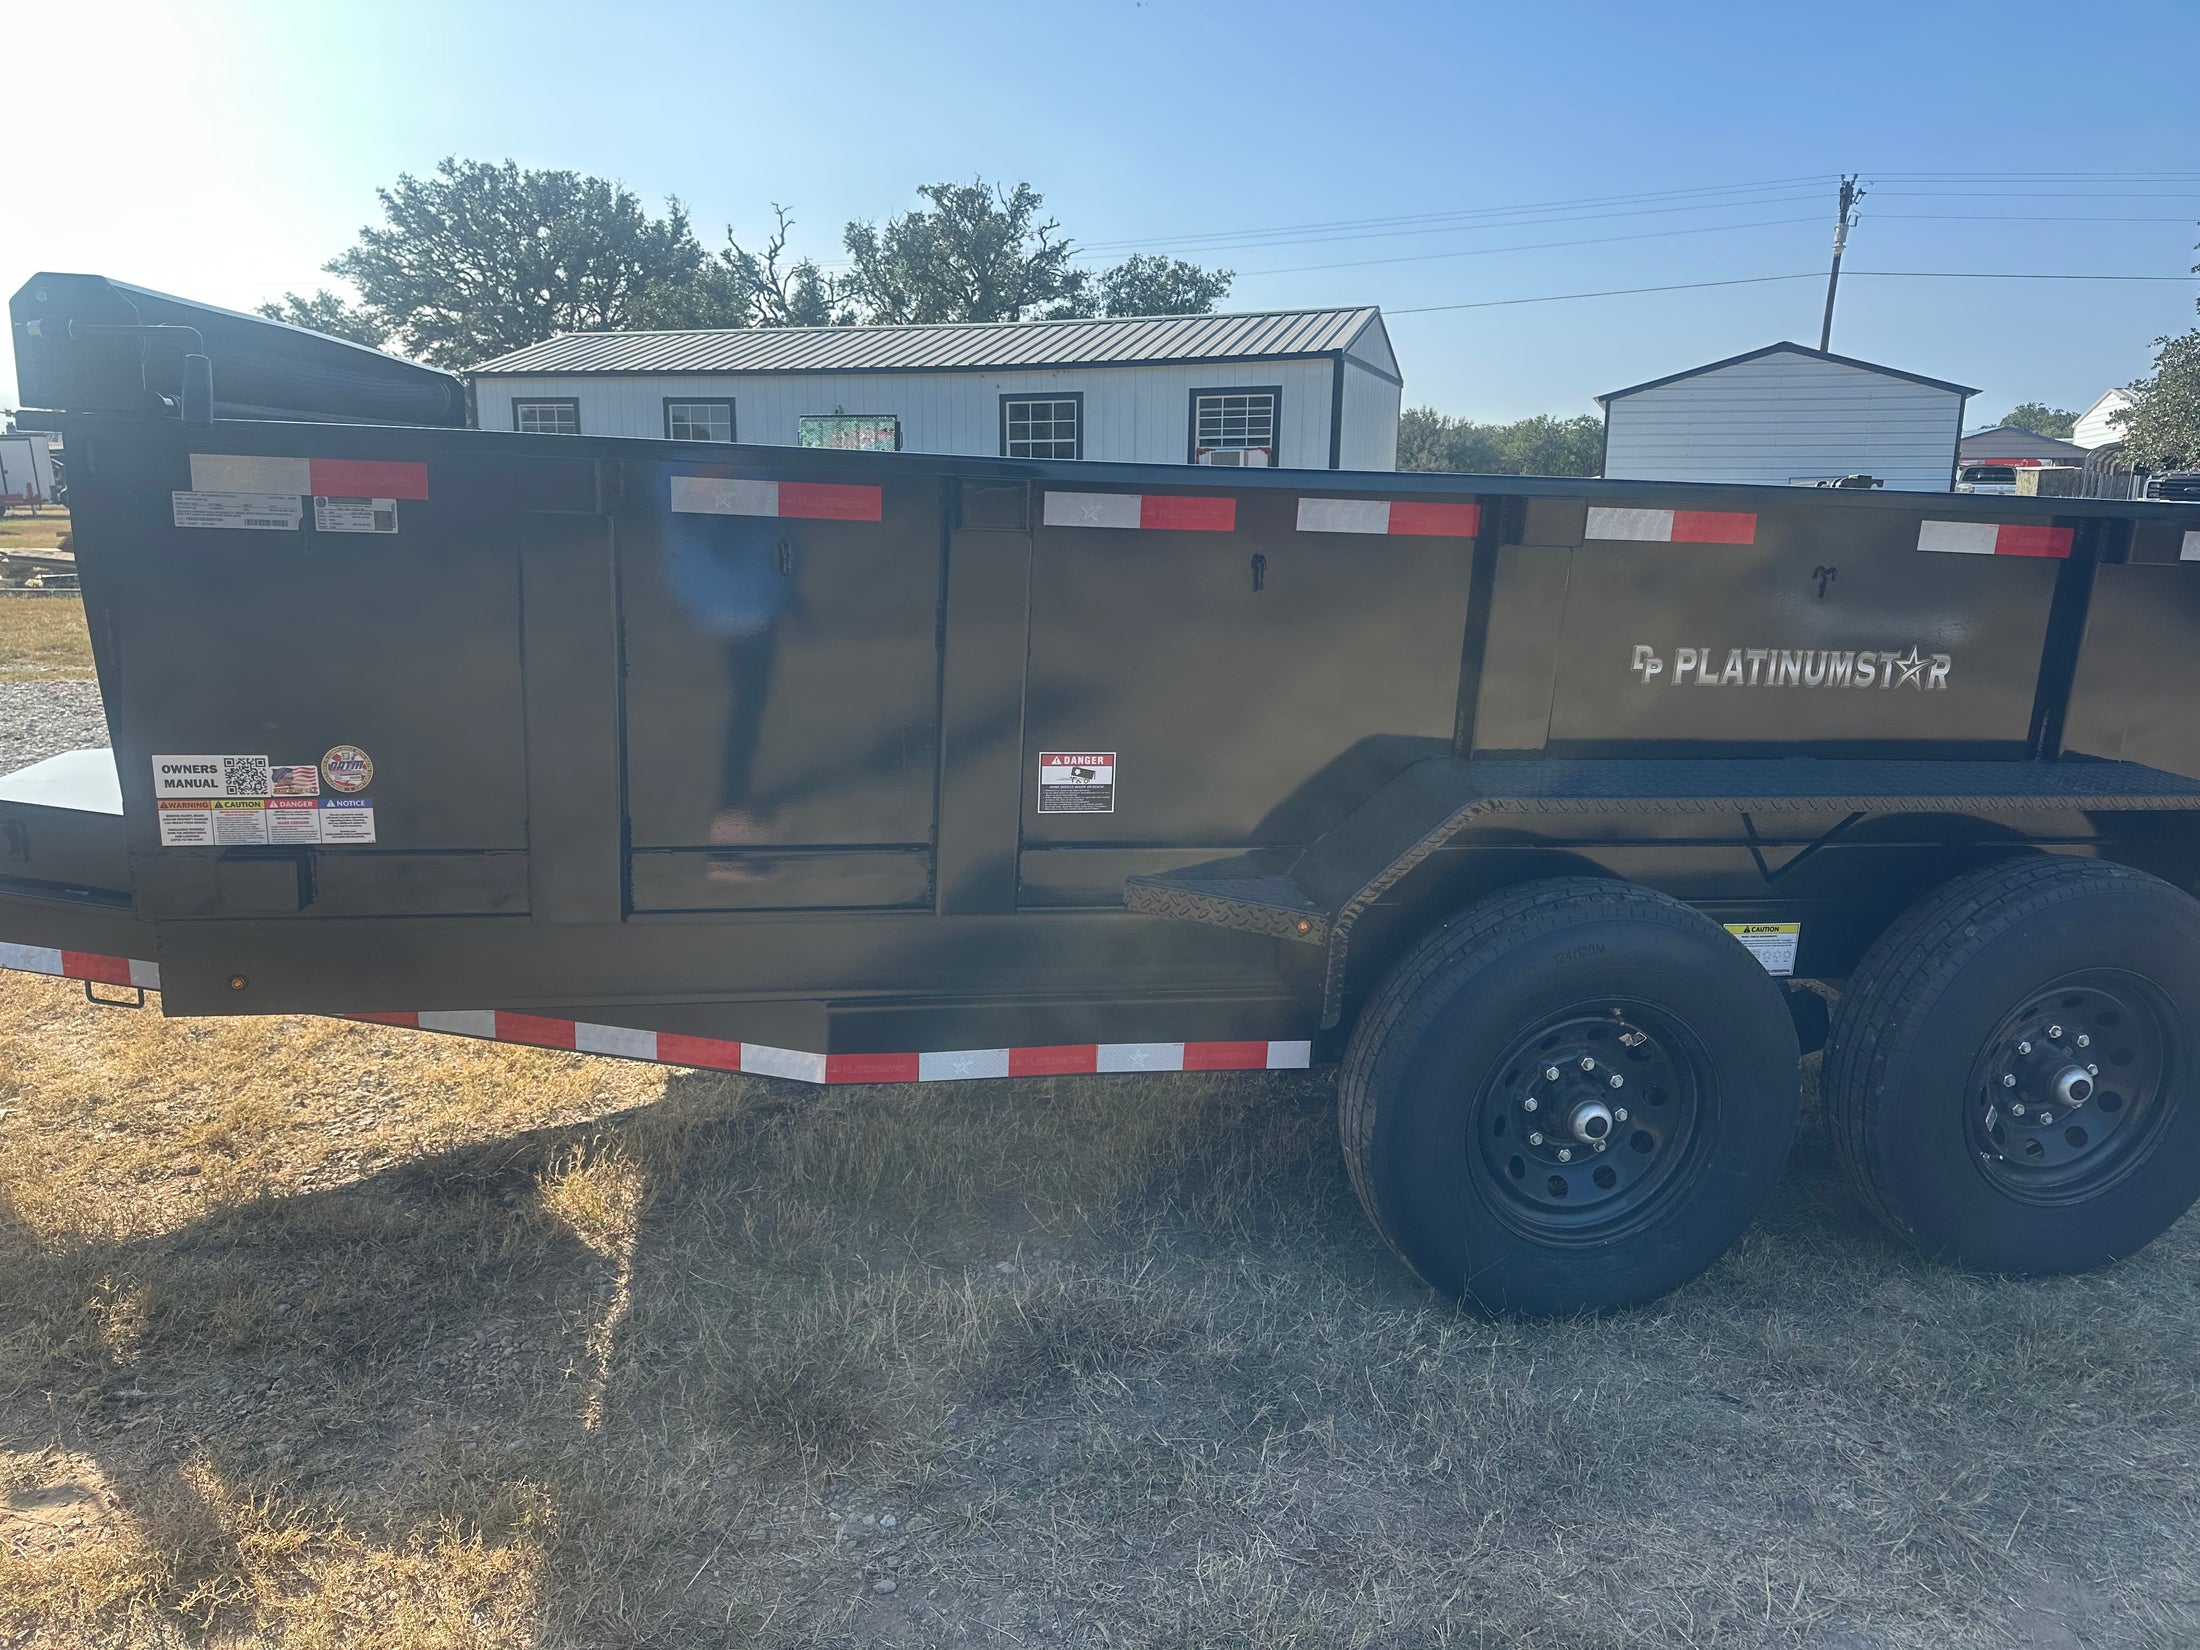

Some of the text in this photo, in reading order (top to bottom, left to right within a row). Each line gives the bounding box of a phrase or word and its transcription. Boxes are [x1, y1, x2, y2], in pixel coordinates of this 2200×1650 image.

[1064, 756, 1104, 765] DANGER
[161, 764, 218, 774] OWNERS
[164, 779, 219, 788] MANUAL
[168, 801, 209, 809] WARNING
